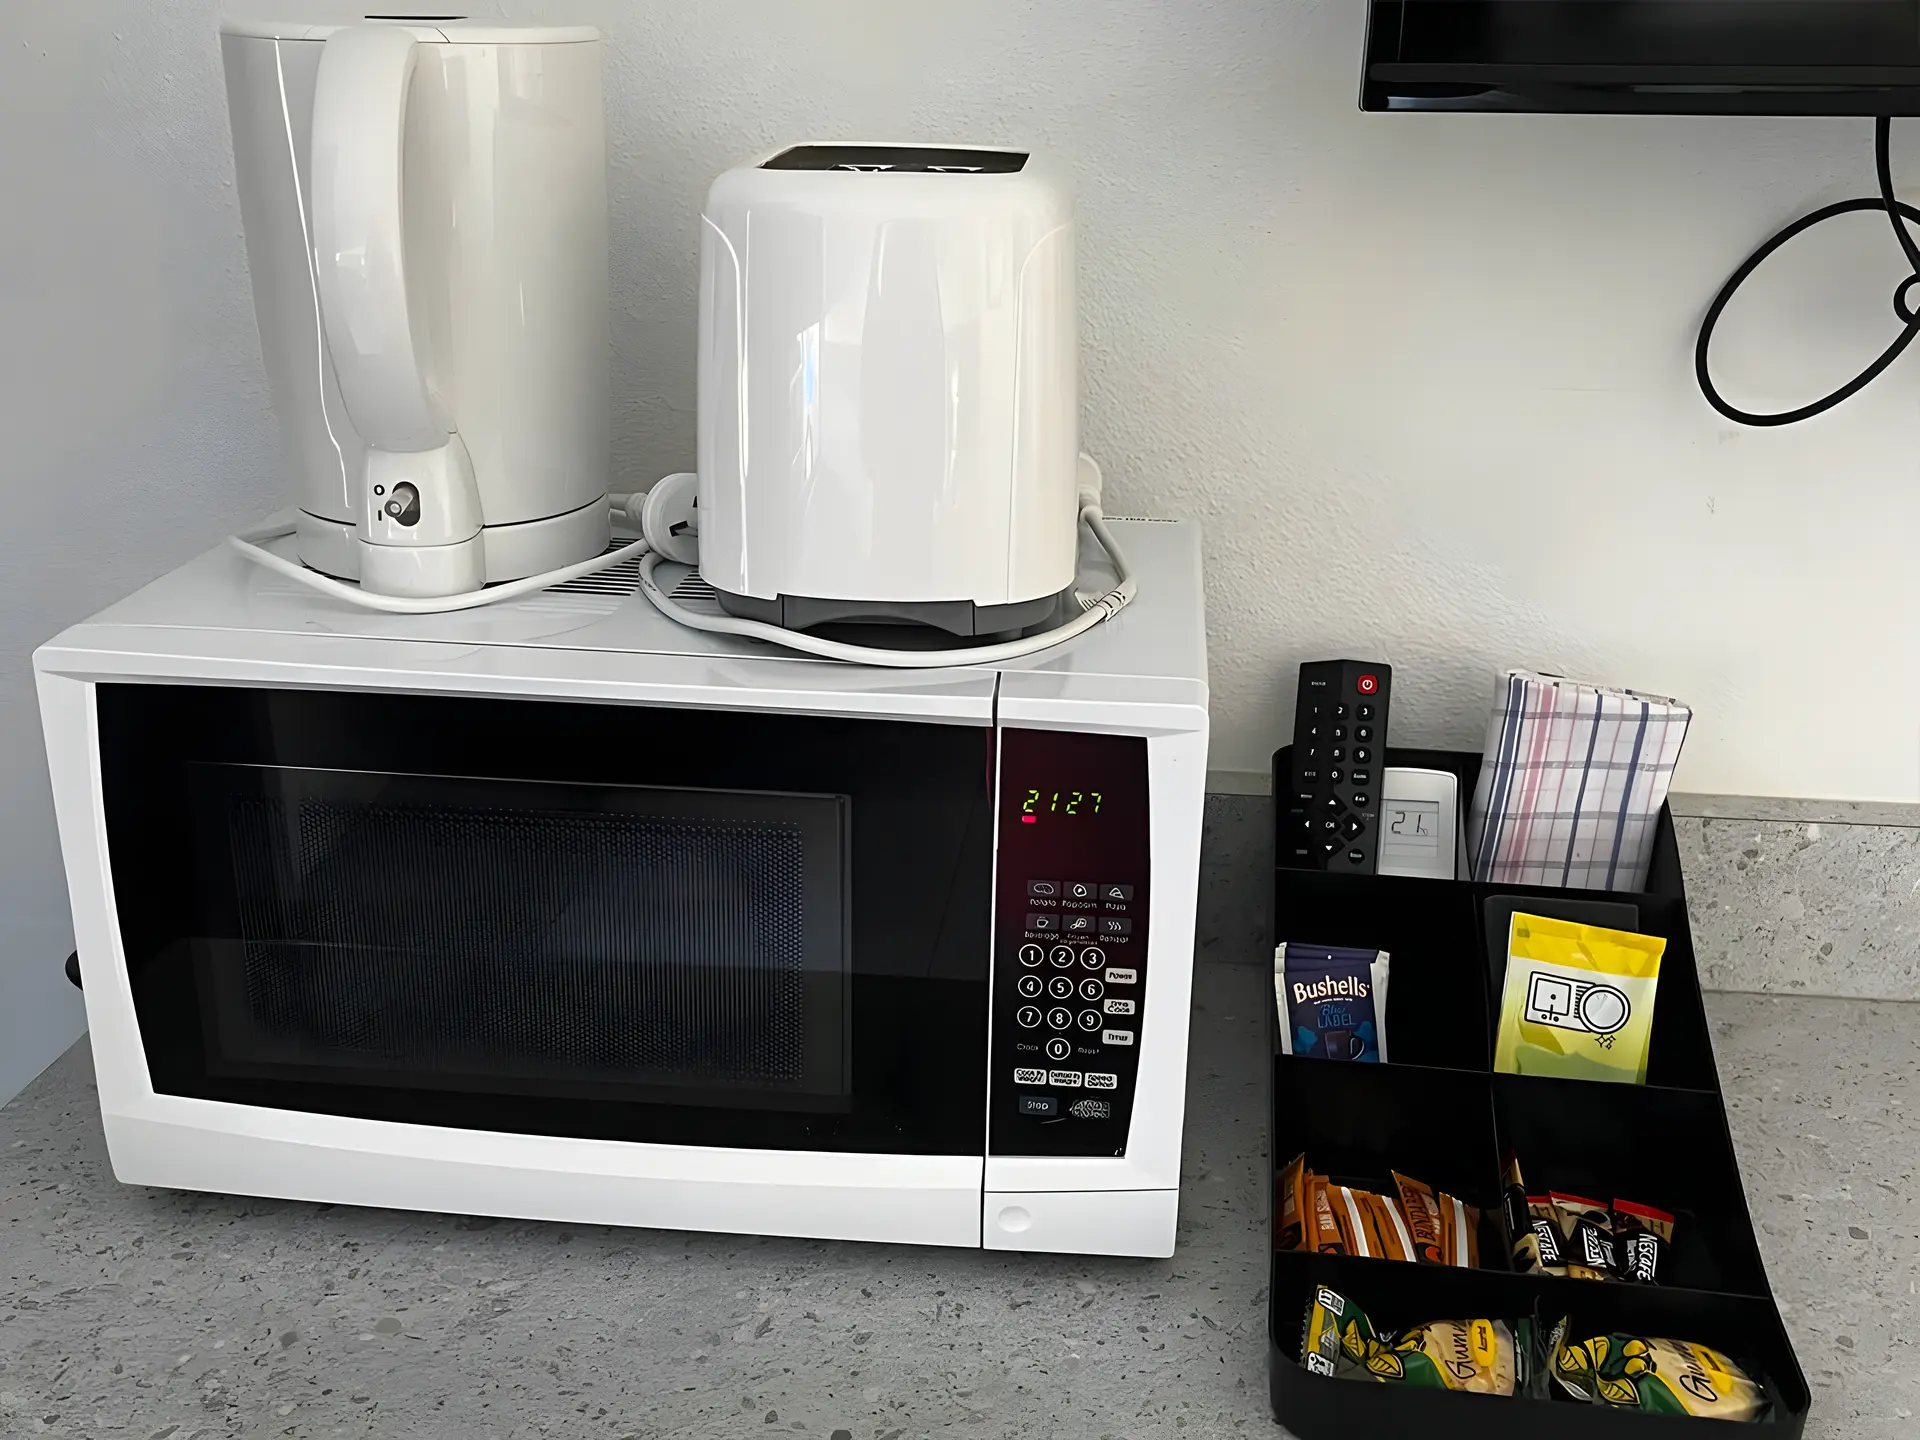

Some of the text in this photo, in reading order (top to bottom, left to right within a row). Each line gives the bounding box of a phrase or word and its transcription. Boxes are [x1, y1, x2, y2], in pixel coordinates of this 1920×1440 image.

[1058, 951, 1066, 963] 2
[1089, 953, 1097, 964] 3
[1026, 981, 1096, 995] 4 5 6
[1293, 975, 1368, 1004] Bushells
[1026, 1011, 1094, 1026] 7 8 9
[1054, 1043, 1063, 1055] 0
